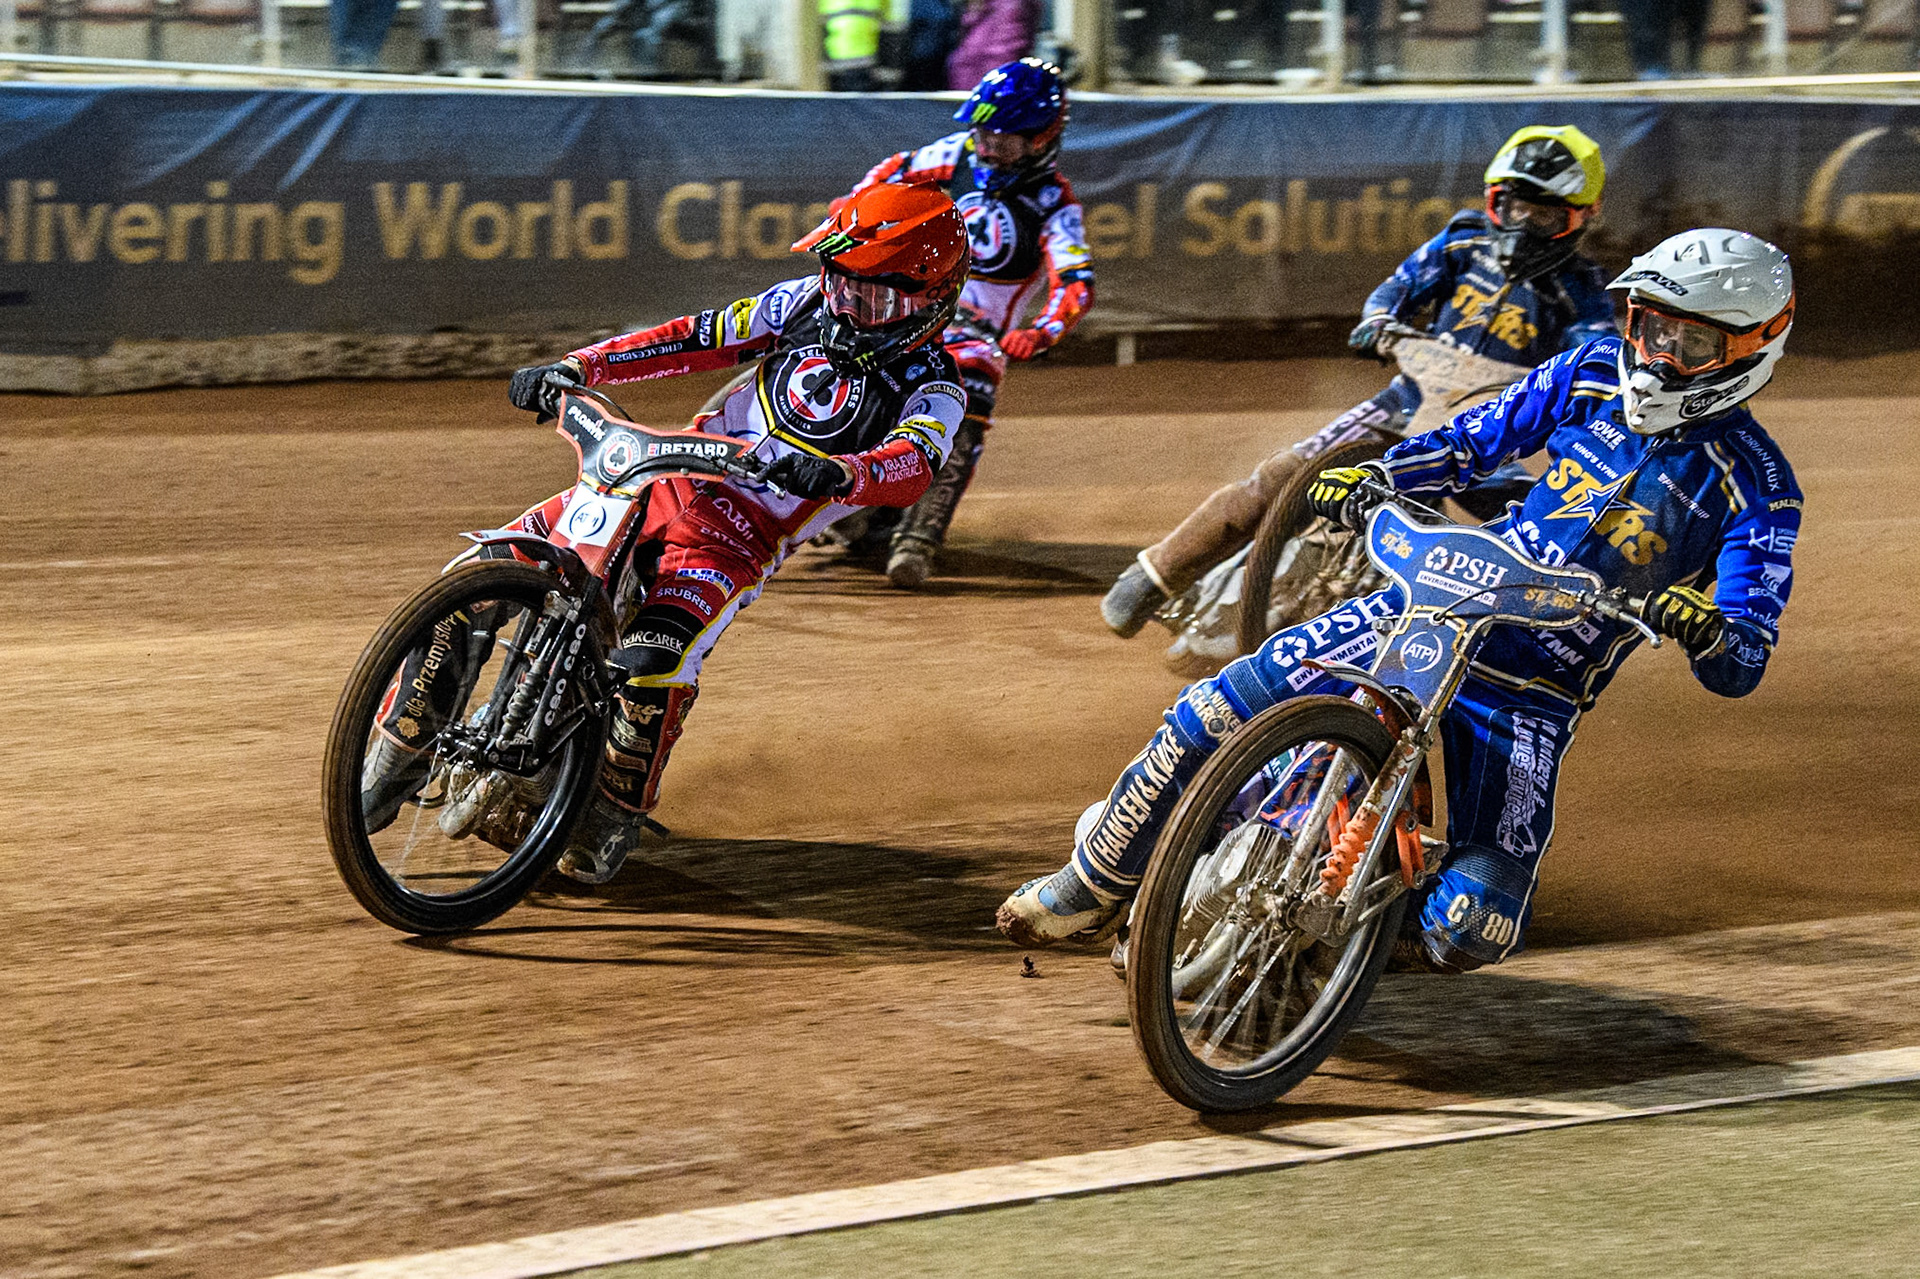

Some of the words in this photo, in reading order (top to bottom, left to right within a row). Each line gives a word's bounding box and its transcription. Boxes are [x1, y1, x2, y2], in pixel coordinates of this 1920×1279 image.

[0, 179, 345, 284] livering
[371, 179, 630, 261] World
[656, 180, 830, 260] Cla
[1181, 179, 1488, 258] Solutio
[848, 379, 861, 409] ACES
[661, 443, 728, 458] BETARD
[1572, 441, 1600, 466] KING'S
[1596, 460, 1619, 480] LYNN
[1735, 429, 1769, 462] ADRIAN
[1764, 460, 1781, 491] FLUX
[1445, 551, 1509, 588] PSH
[1302, 594, 1395, 650] PSH
[1404, 642, 1437, 663] ATPI
[1532, 627, 1585, 666] YNN
[1092, 784, 1152, 867] HANSEN
[1134, 774, 1160, 802] &
